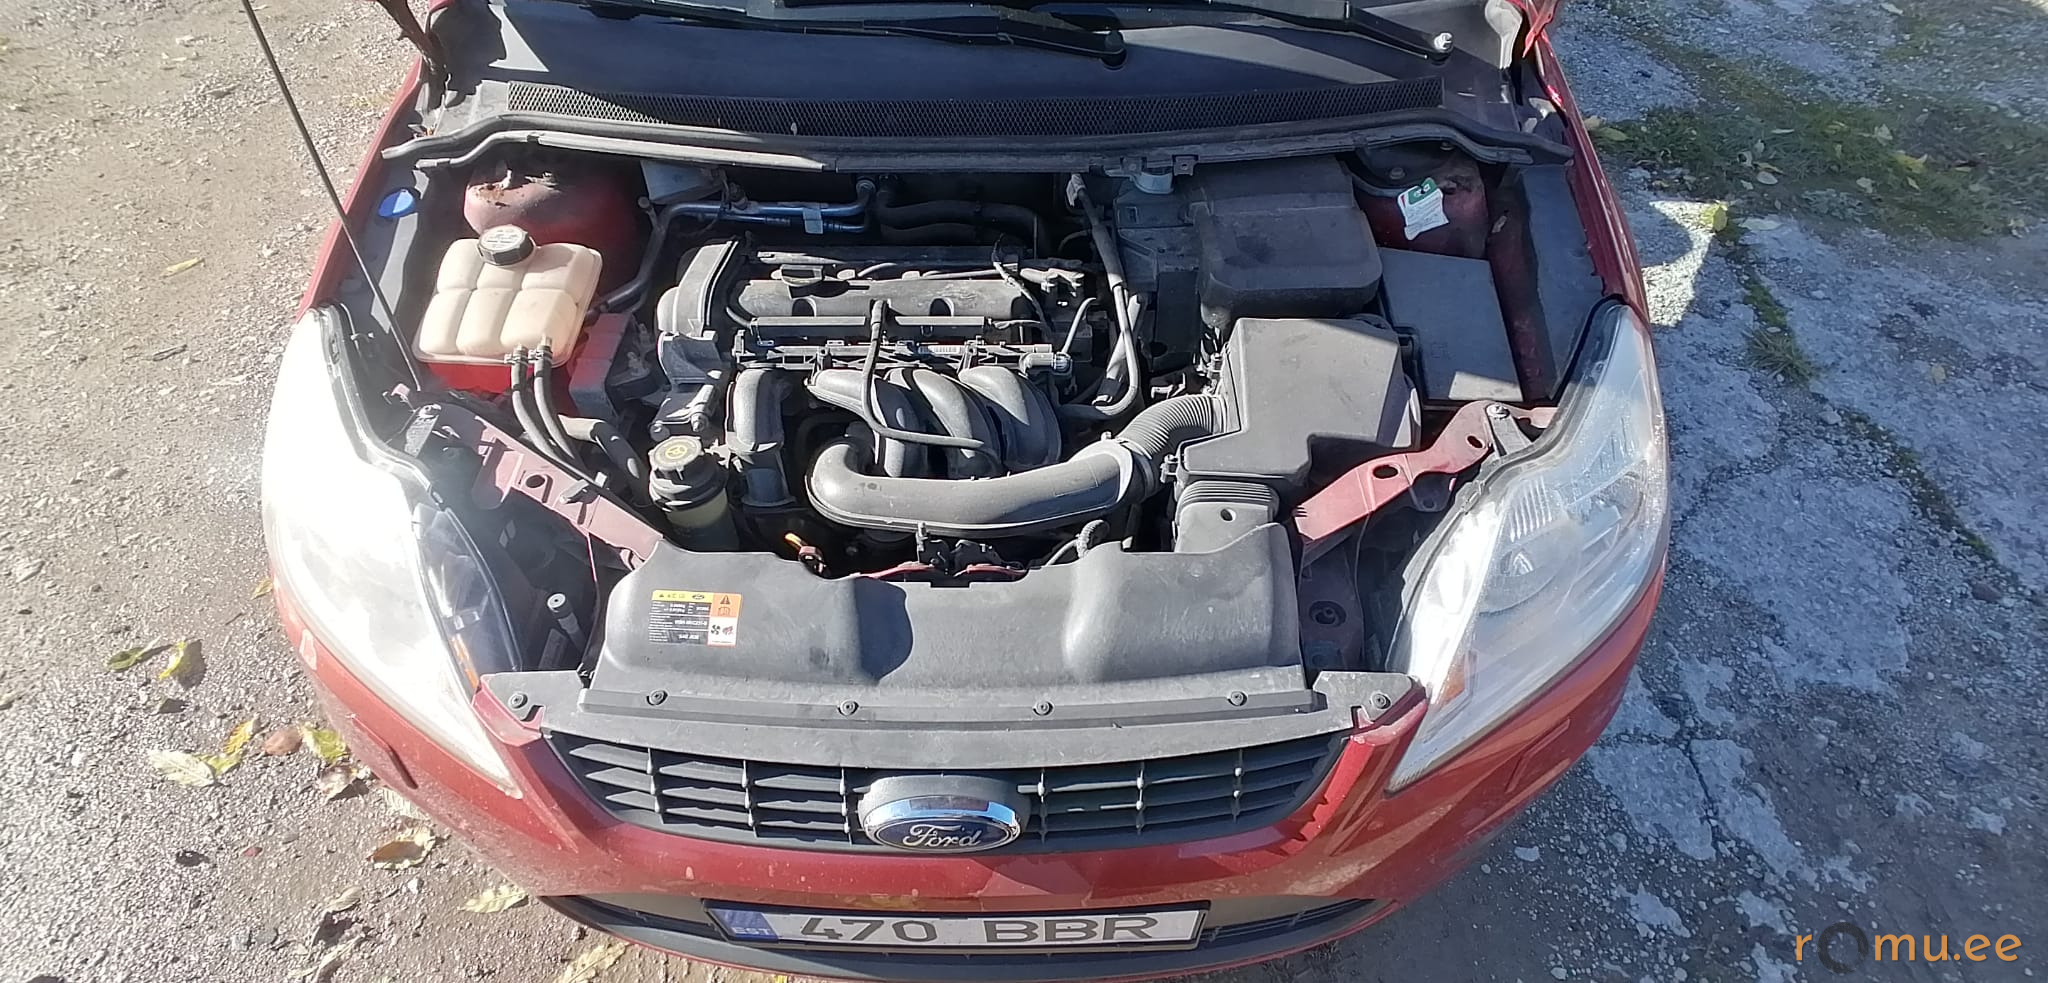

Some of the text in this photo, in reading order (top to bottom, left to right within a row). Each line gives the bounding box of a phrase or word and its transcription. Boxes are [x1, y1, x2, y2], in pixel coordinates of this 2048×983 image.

[902, 823, 981, 848] Ford
[731, 926, 771, 936] EST
[800, 916, 1159, 943] 470 BBR
